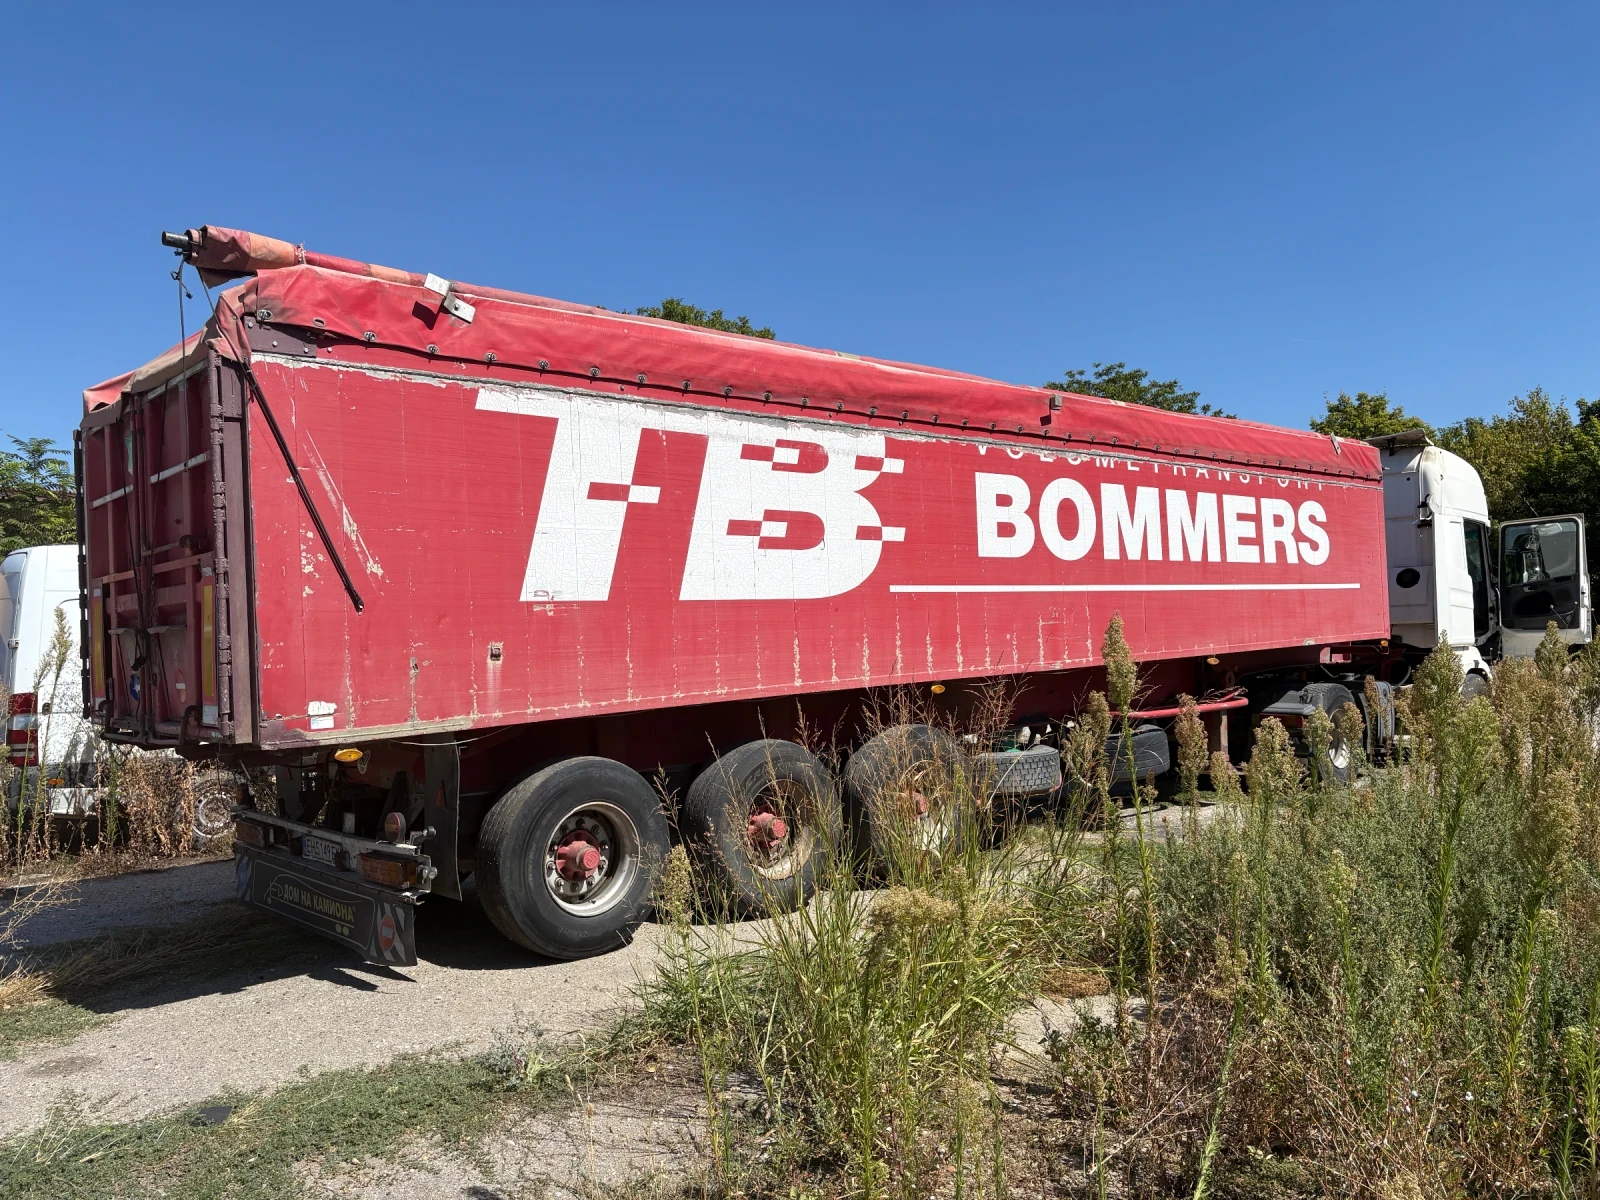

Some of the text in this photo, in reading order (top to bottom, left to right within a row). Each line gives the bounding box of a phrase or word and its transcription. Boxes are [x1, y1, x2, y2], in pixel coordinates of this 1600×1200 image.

[974, 470, 1331, 566] BOMMERS
[283, 883, 355, 922] ДОМ НА КАМИОНА
